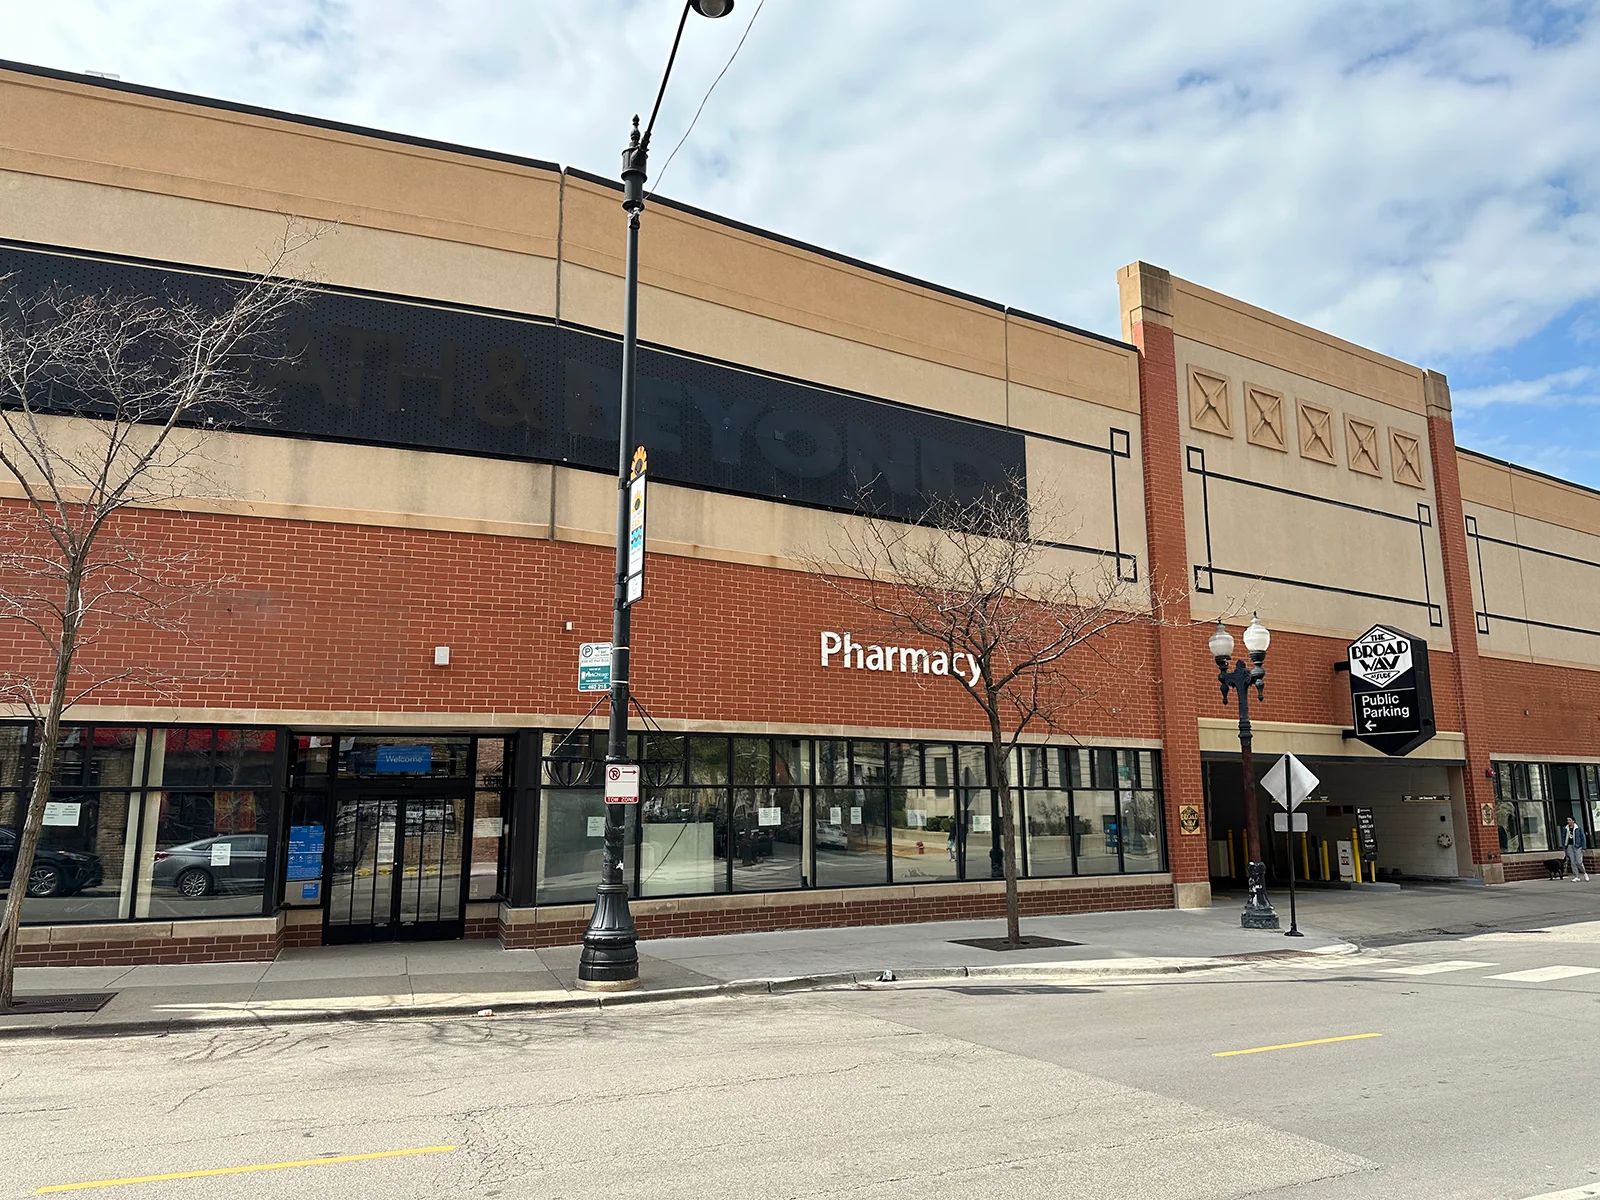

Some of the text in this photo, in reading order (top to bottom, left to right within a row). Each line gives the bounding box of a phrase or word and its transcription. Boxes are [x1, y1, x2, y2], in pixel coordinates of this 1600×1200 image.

[1370, 633, 1385, 641] THE
[1351, 640, 1408, 660] BROAD
[820, 631, 984, 688] Pharmacy
[1362, 693, 1400, 706] Public
[1363, 706, 1410, 719] Parking
[385, 755, 423, 763] Welcome
